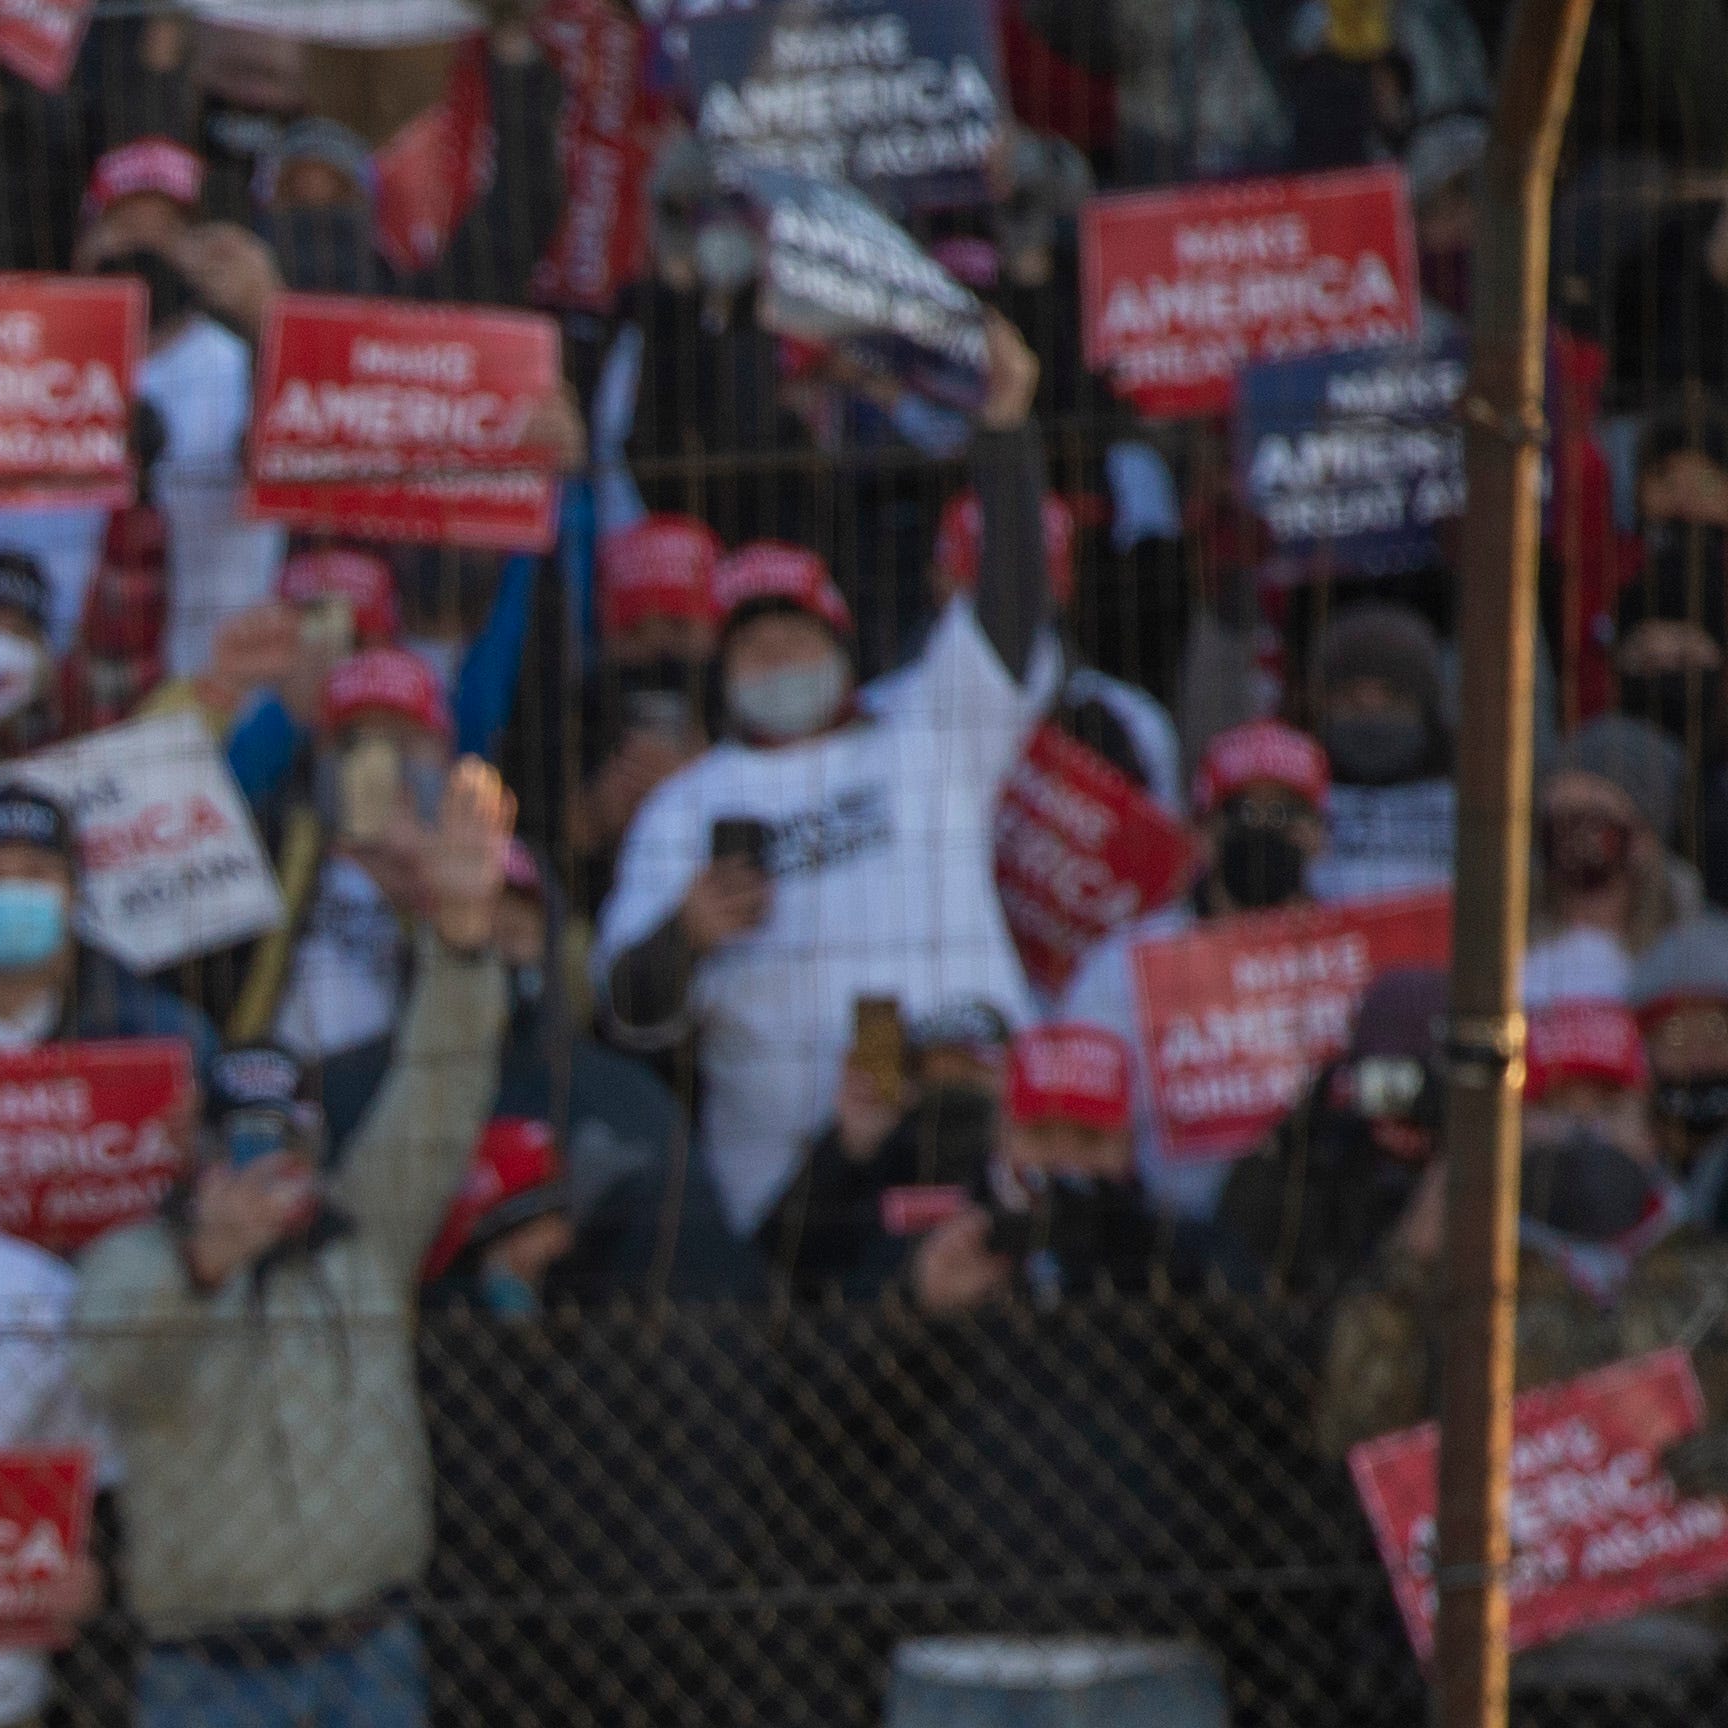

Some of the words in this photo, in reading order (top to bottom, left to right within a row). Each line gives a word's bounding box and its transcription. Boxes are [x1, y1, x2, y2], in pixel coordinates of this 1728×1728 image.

[699, 54, 994, 139] AMERICA
[1172, 211, 1311, 263] MAKE
[1103, 251, 1399, 330] AMERICA
[348, 336, 477, 387] MAKE
[1231, 932, 1370, 991] MAKE
